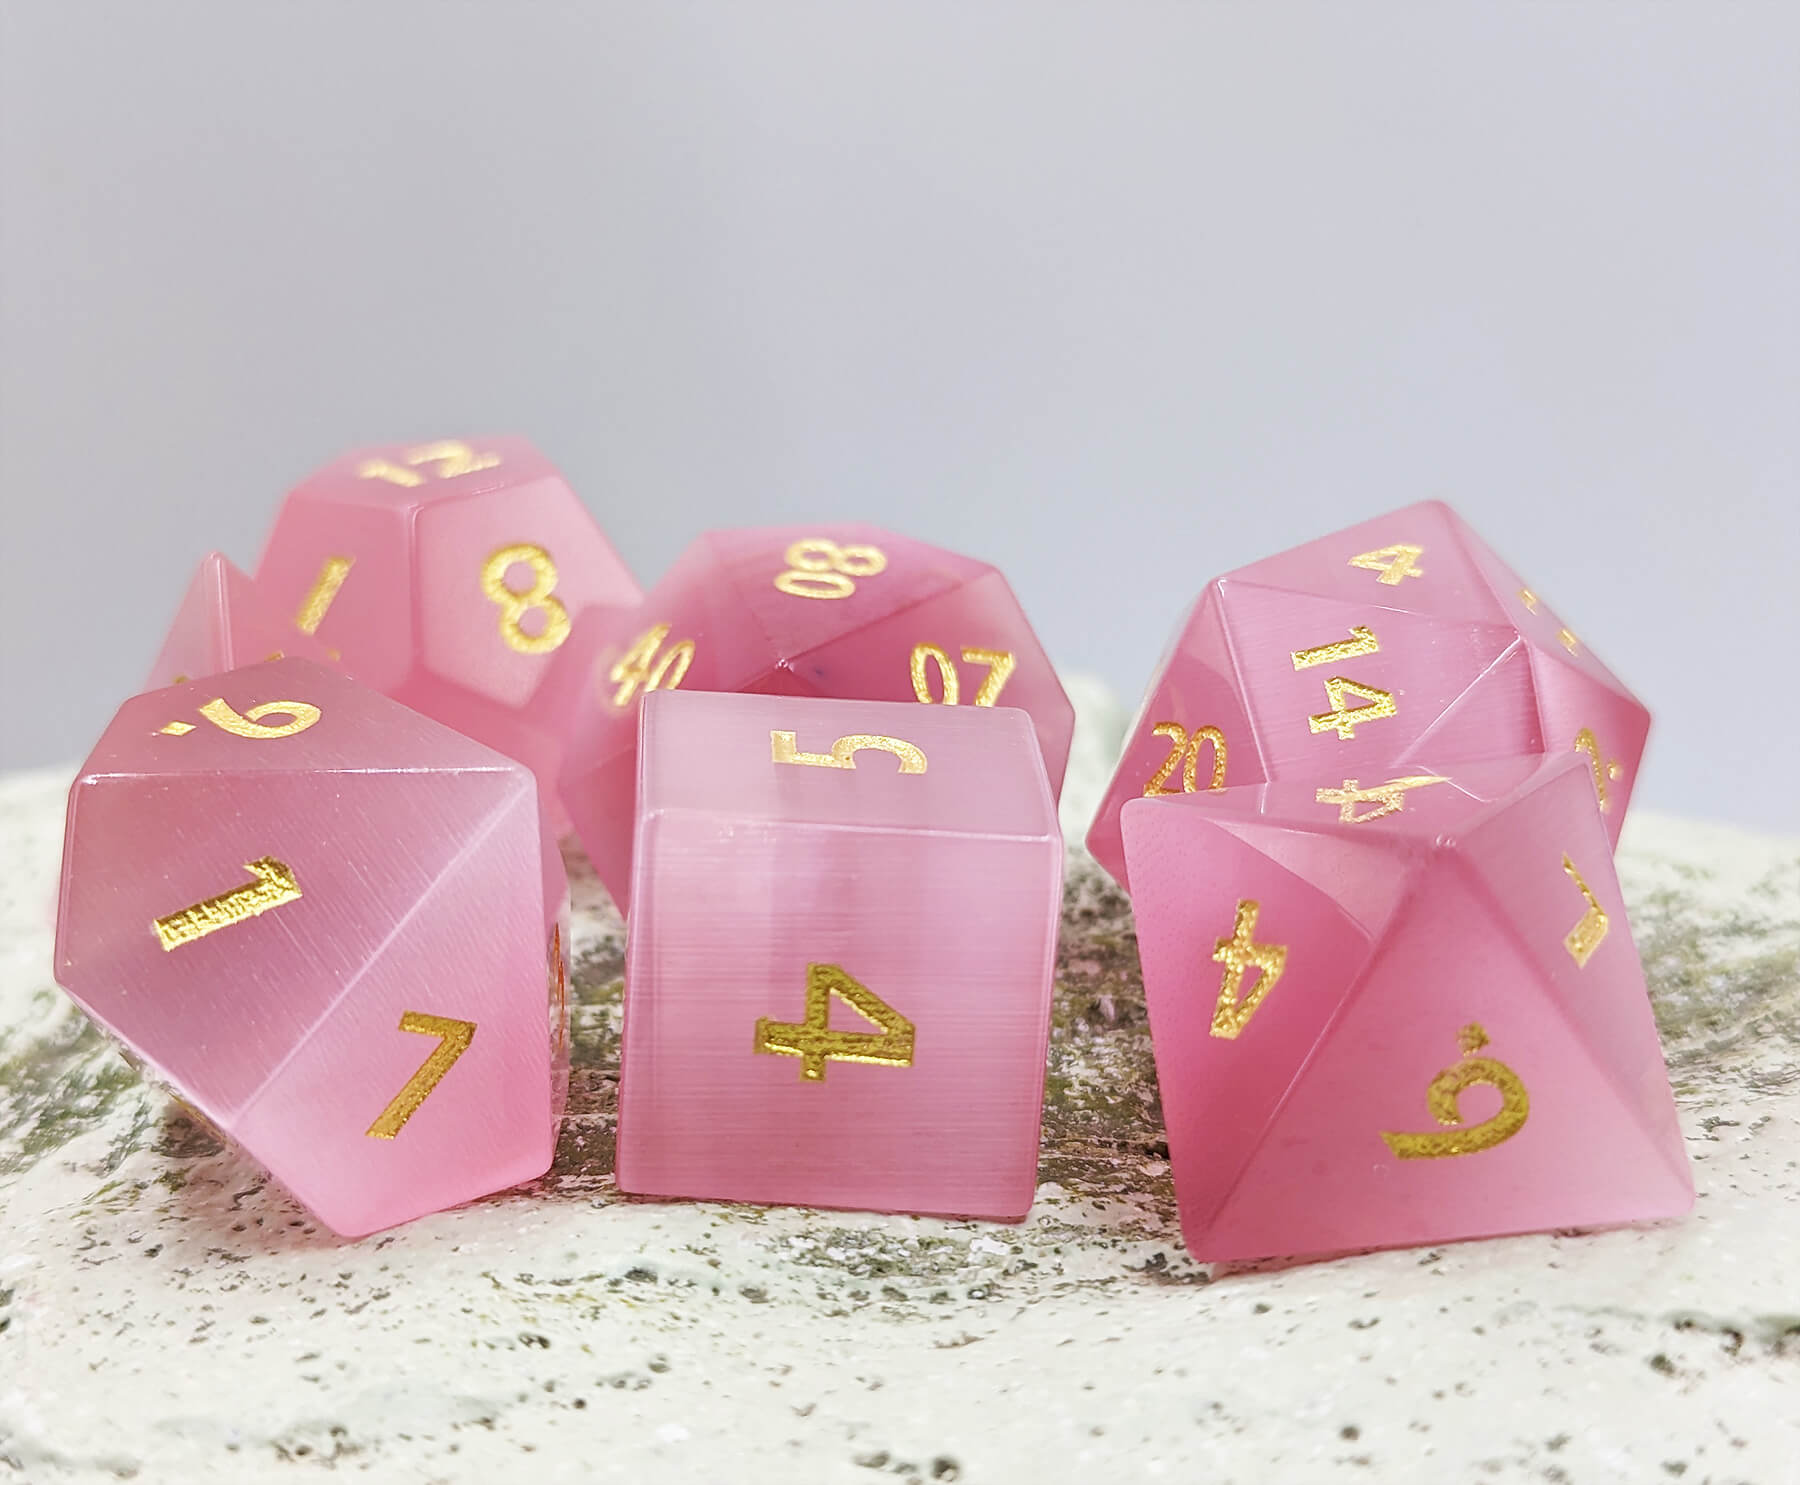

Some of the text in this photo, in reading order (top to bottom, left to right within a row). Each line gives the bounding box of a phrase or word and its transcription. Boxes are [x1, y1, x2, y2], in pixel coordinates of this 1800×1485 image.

[357, 439, 501, 488] 12
[480, 541, 572, 655] 8
[1347, 544, 1424, 586] 4
[609, 623, 696, 706] 40
[1289, 625, 1398, 740] 14
[769, 729, 928, 775] 5
[1142, 720, 1228, 798] 20
[152, 856, 303, 952] 1
[1211, 899, 1288, 1039] 4
[753, 962, 916, 1082] 4
[365, 1010, 478, 1140] 7
